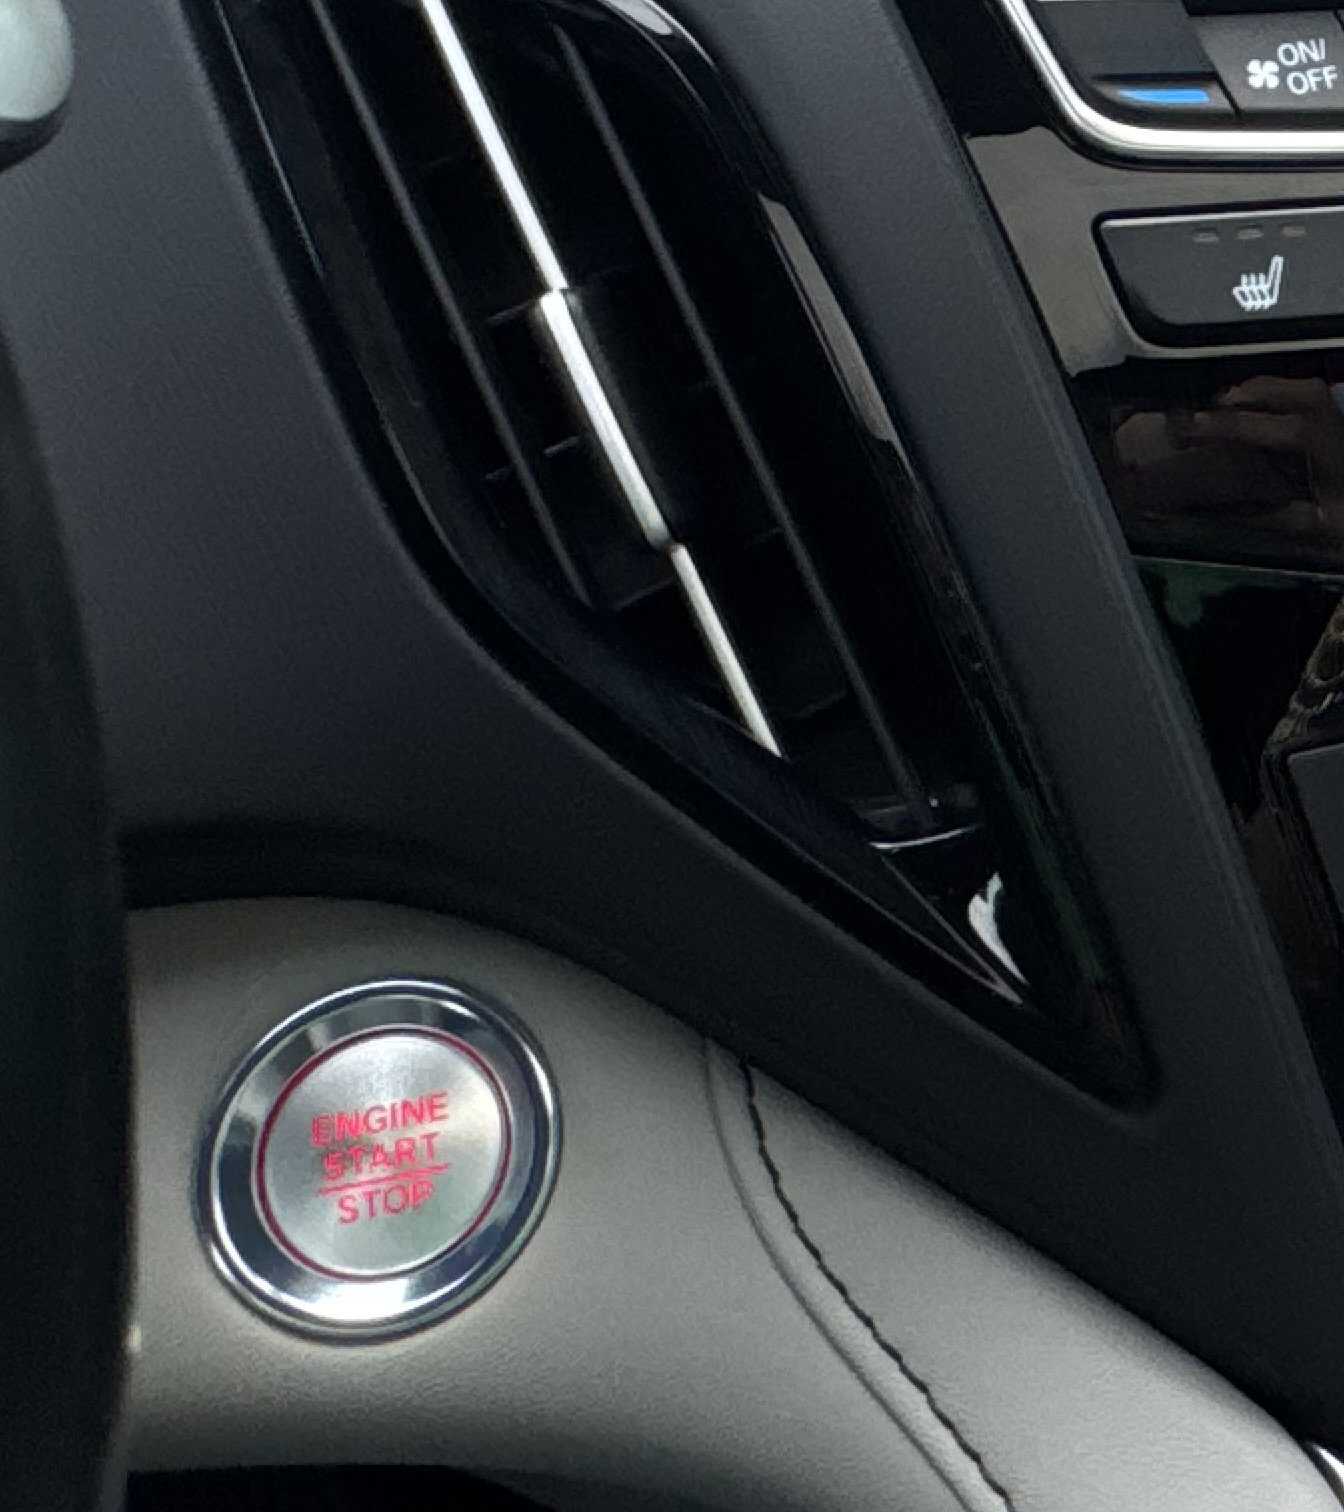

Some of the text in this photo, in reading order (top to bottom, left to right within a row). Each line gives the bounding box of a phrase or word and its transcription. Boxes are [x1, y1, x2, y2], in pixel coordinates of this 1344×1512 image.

[1277, 38, 1327, 68] ON/
[1286, 64, 1338, 96] OFF
[310, 1090, 448, 1149] ENGINE
[322, 1132, 440, 1182] START
[338, 1177, 434, 1226] STOP
